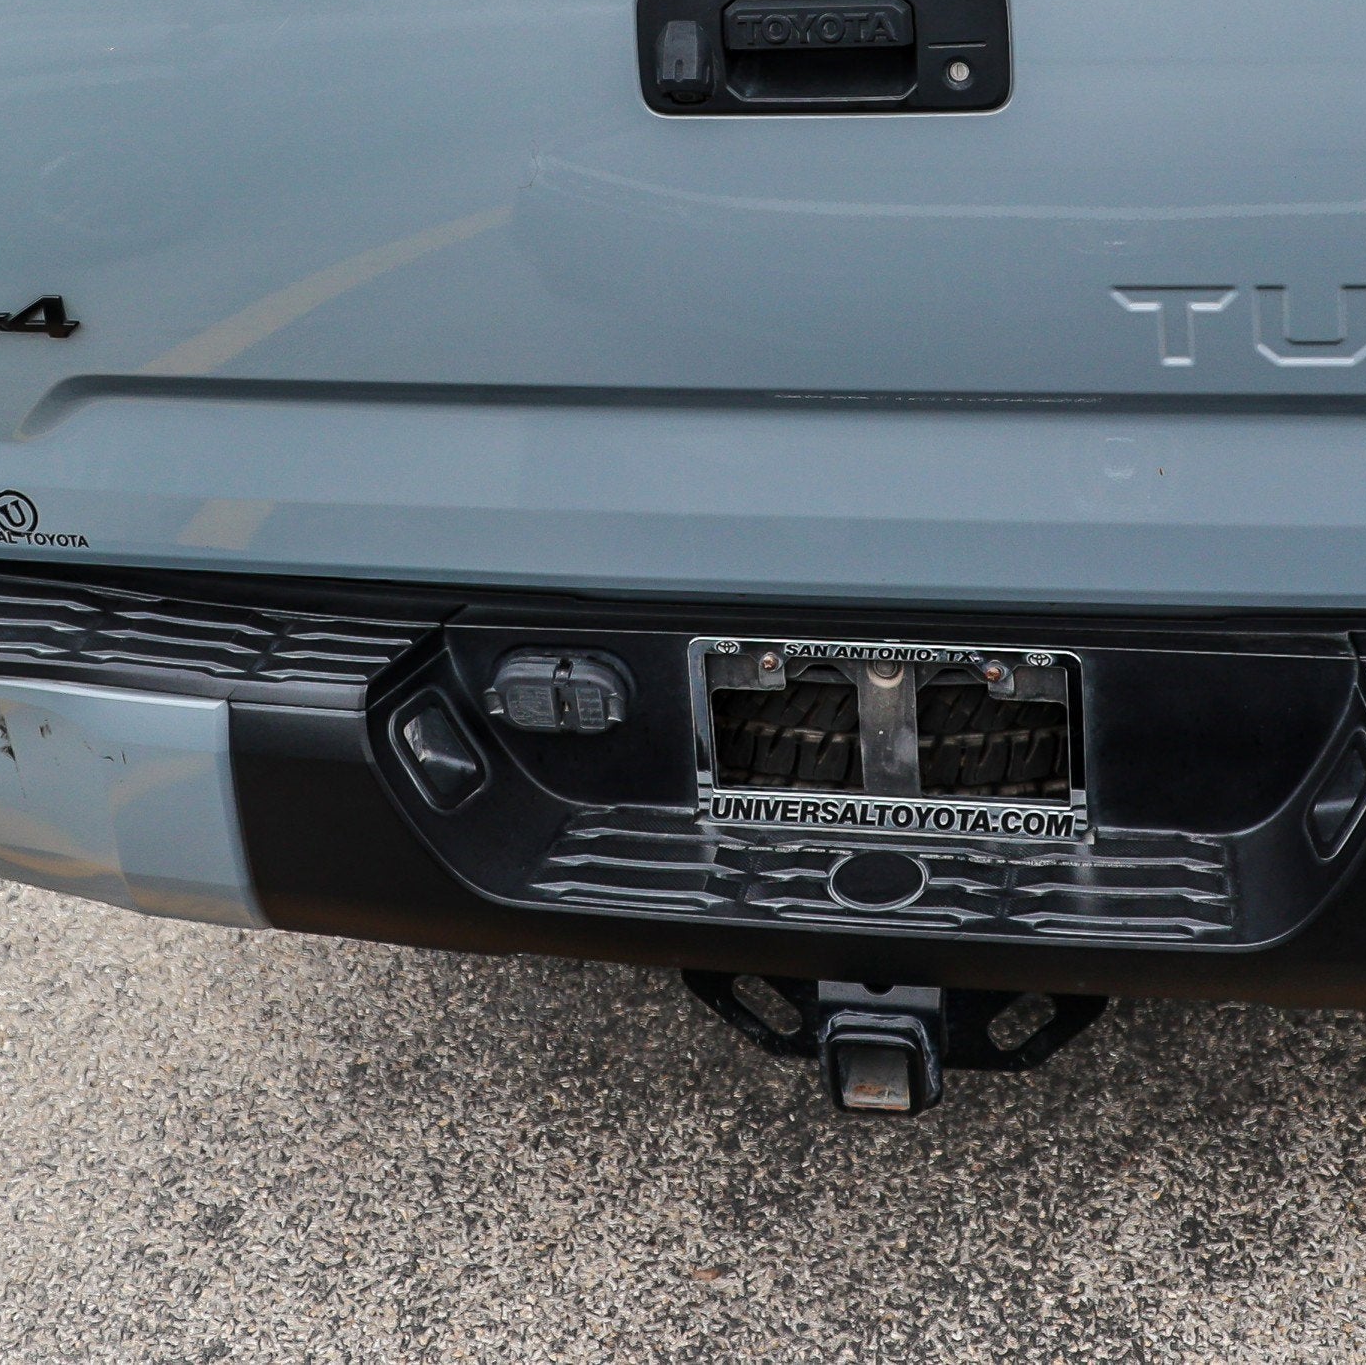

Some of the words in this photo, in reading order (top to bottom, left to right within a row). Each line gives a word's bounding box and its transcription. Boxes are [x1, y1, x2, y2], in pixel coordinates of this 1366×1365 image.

[737, 11, 899, 46] TOYOTA
[25, 533, 90, 548] TOYOTA
[785, 643, 829, 658] SAN
[711, 796, 1077, 837] UNIVERSALTOYOTA.COM
